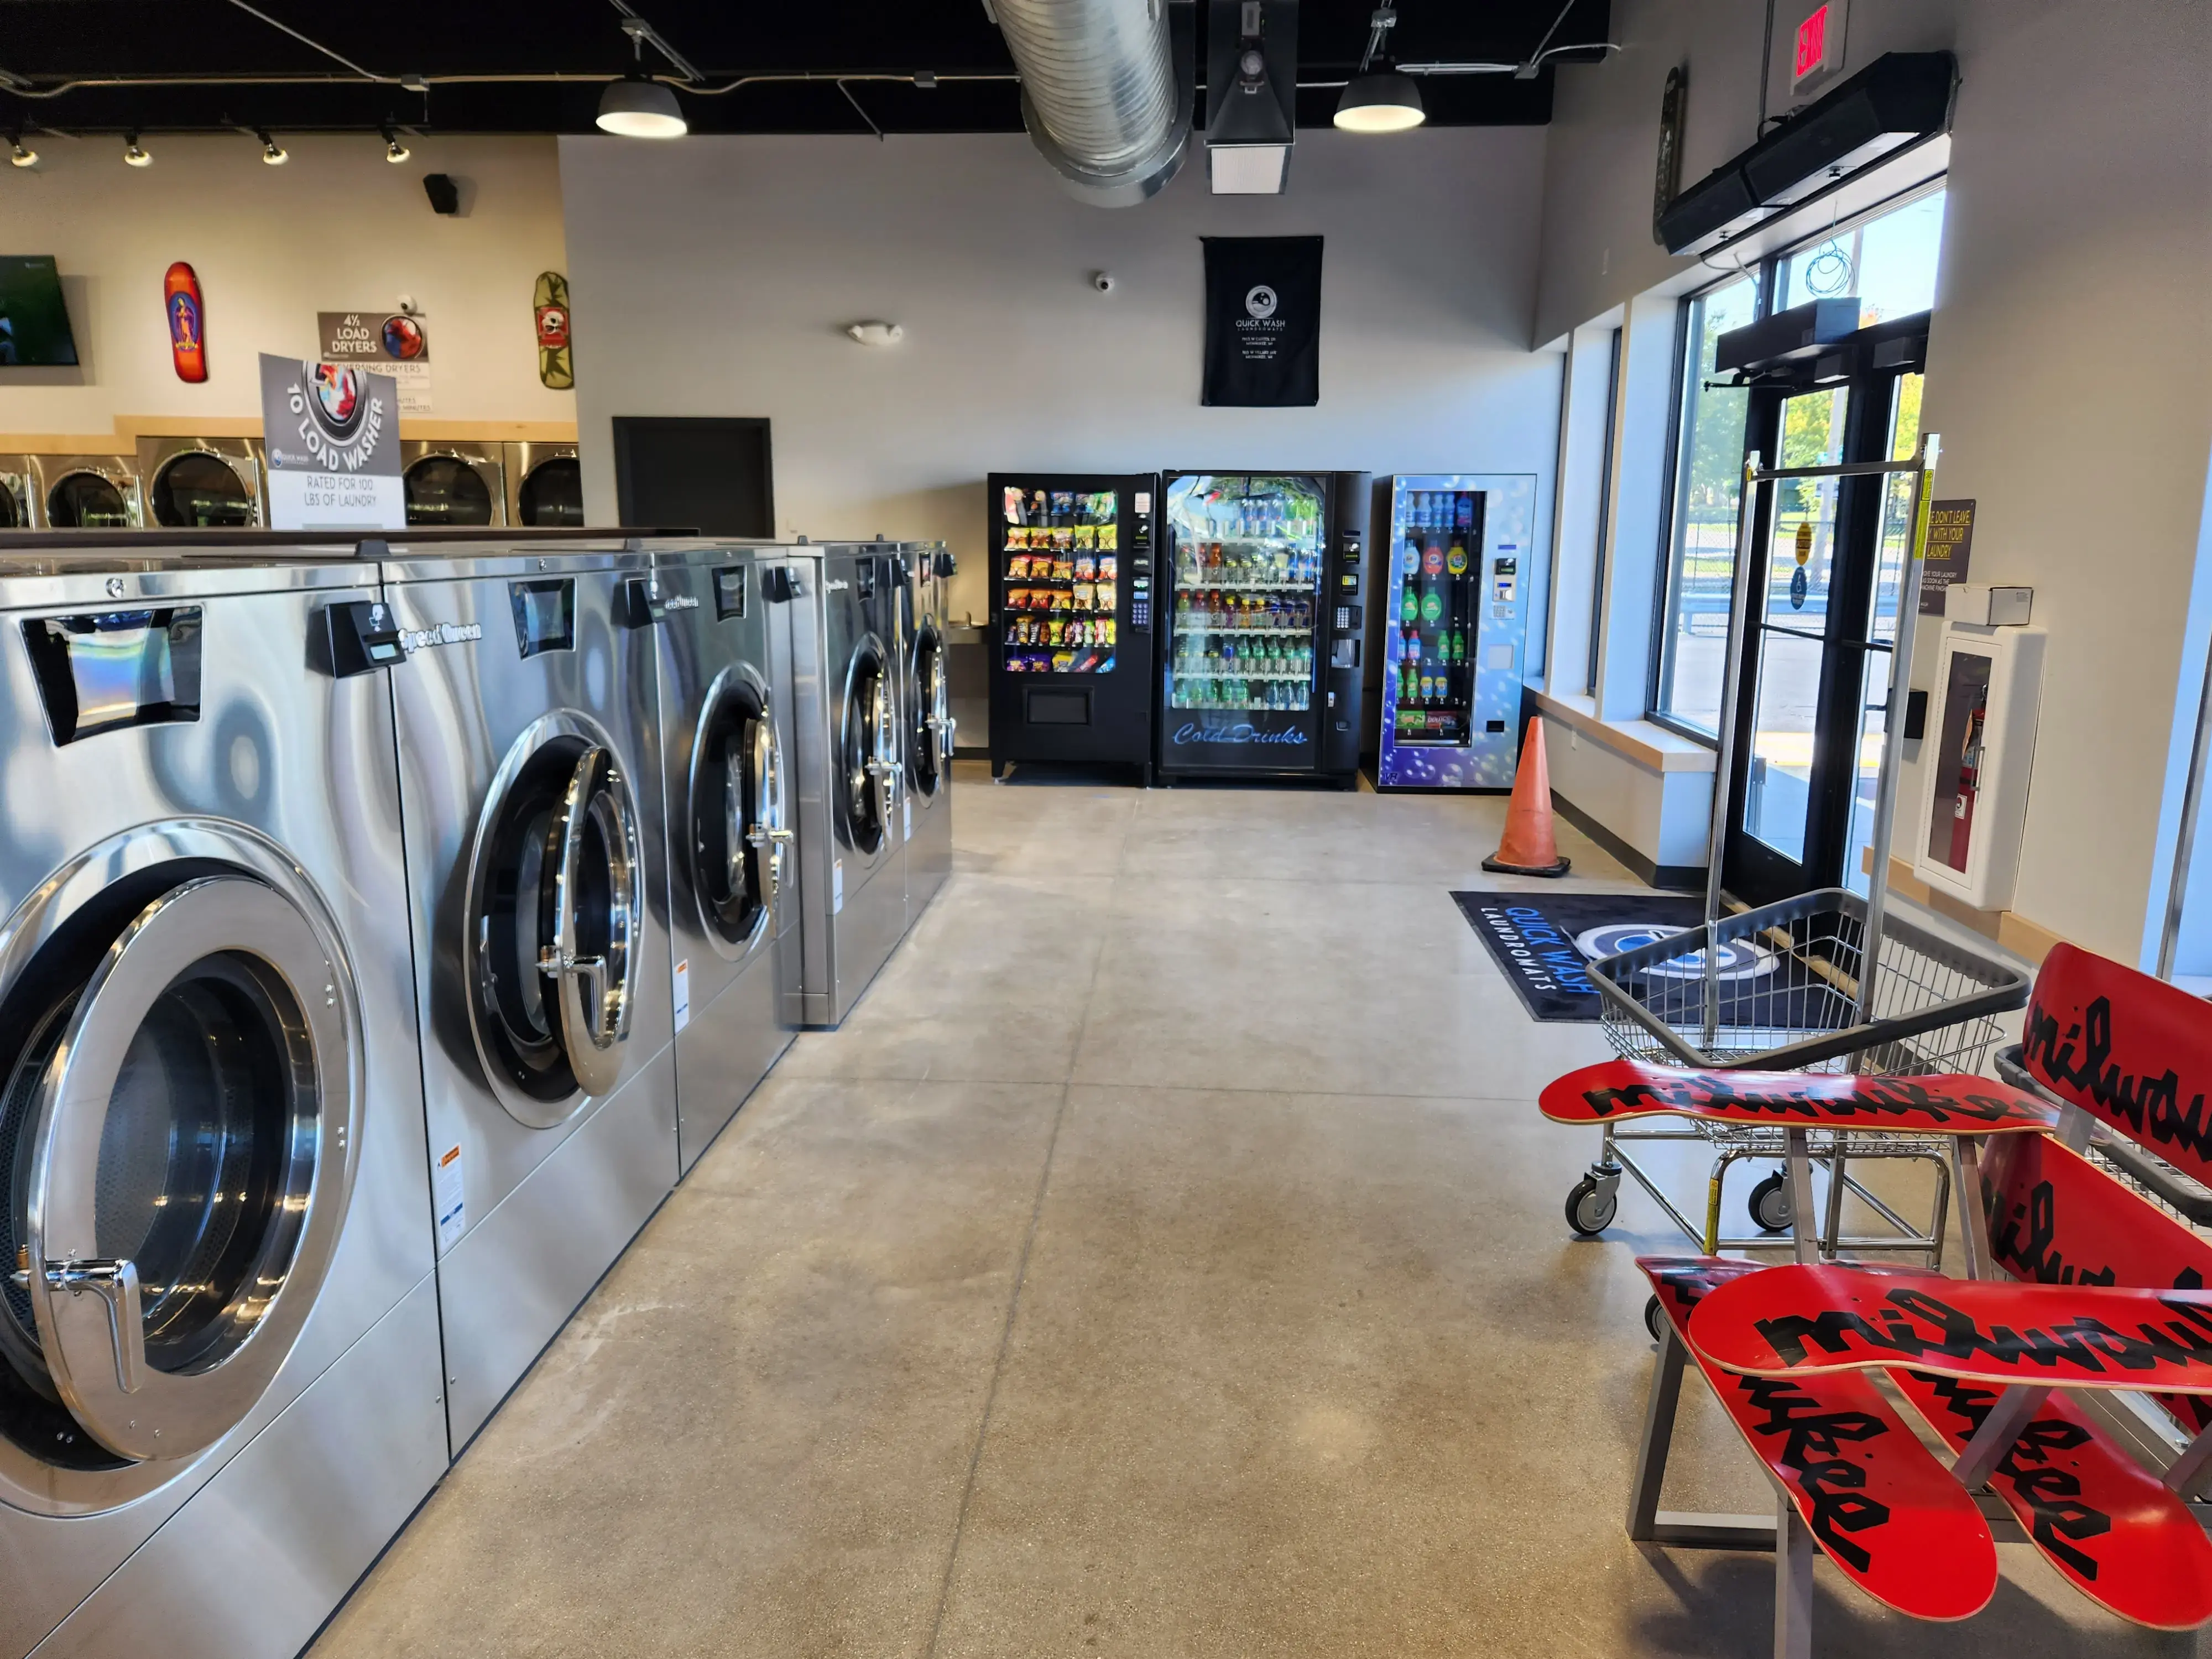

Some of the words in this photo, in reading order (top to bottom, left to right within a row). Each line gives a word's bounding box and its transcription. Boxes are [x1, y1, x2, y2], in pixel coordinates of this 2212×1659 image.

[337, 327, 369, 340] LOAD
[332, 341, 377, 352] DRYERS
[386, 364, 420, 373] DRYERS
[287, 382, 304, 414] 10
[299, 418, 338, 471] LOAD
[343, 398, 383, 472] WASHER
[307, 476, 335, 489] RATED
[338, 477, 356, 490] FOR
[359, 478, 373, 491] 100
[304, 492, 320, 506] LBS
[323, 493, 336, 506] OF
[338, 494, 377, 507] LAUNDRY
[1933, 527, 1947, 540] WITH
[1948, 527, 1963, 540] YOUR
[1927, 544, 1953, 557] LAUNDRY
[1172, 723, 1228, 744] Cold
[1232, 723, 1307, 744] Drinks
[1481, 907, 1557, 989] LAUNDROMATS
[1505, 907, 1567, 945] QUICK
[1538, 950, 1601, 994] WASH
